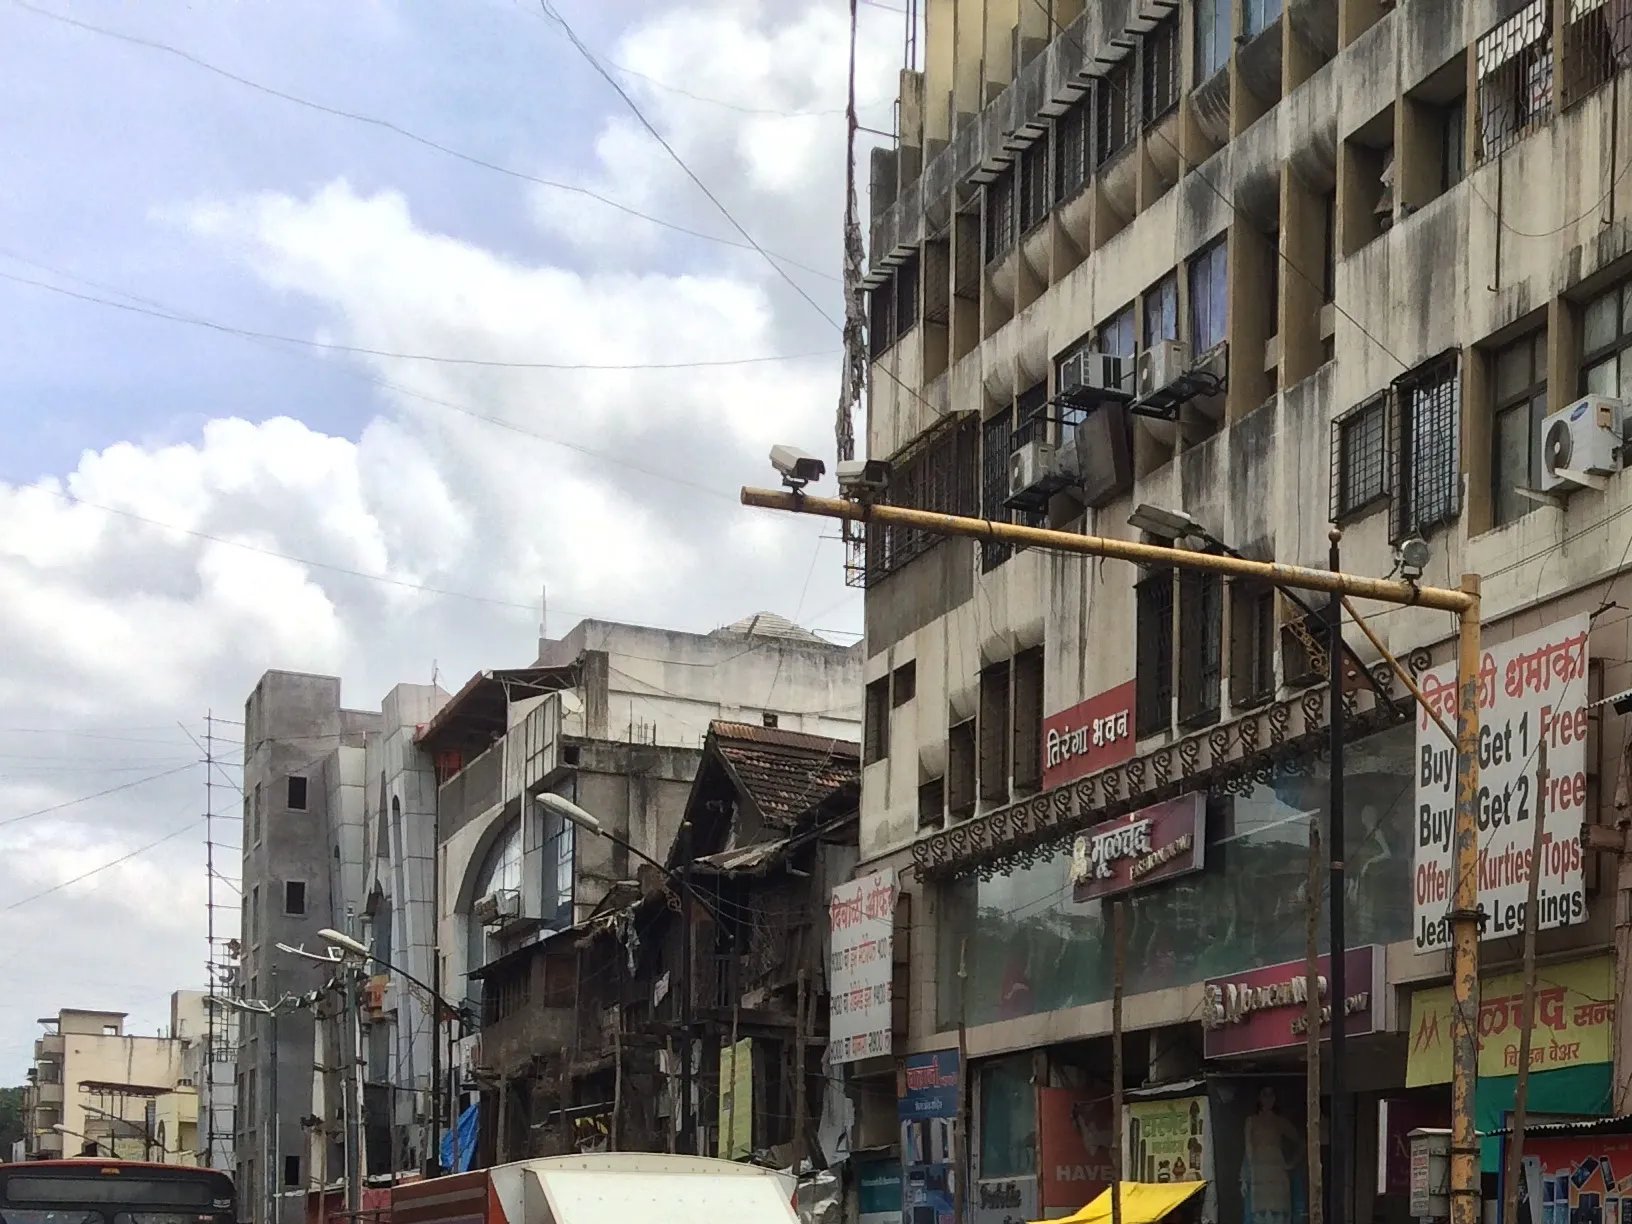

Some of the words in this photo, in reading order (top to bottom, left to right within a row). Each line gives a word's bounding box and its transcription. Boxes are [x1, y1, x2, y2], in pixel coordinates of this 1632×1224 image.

[1504, 631, 1586, 699] धमाका
[1046, 725, 1089, 769] तिरंगा
[1093, 708, 1129, 747] भवन
[1419, 742, 1455, 793] Buy
[1478, 713, 1513, 770] Get
[1517, 711, 1529, 757] 1
[1540, 704, 1588, 750] Free
[1418, 803, 1455, 854] Buy
[1477, 778, 1511, 833] Get
[1517, 775, 1530, 821] 2
[1416, 857, 1452, 906] Offer
[1477, 845, 1533, 892] Kurties
[1416, 915, 1454, 949] Jea
[1493, 889, 1583, 937] Legings
[1549, 1037, 1581, 1063] वेअर
